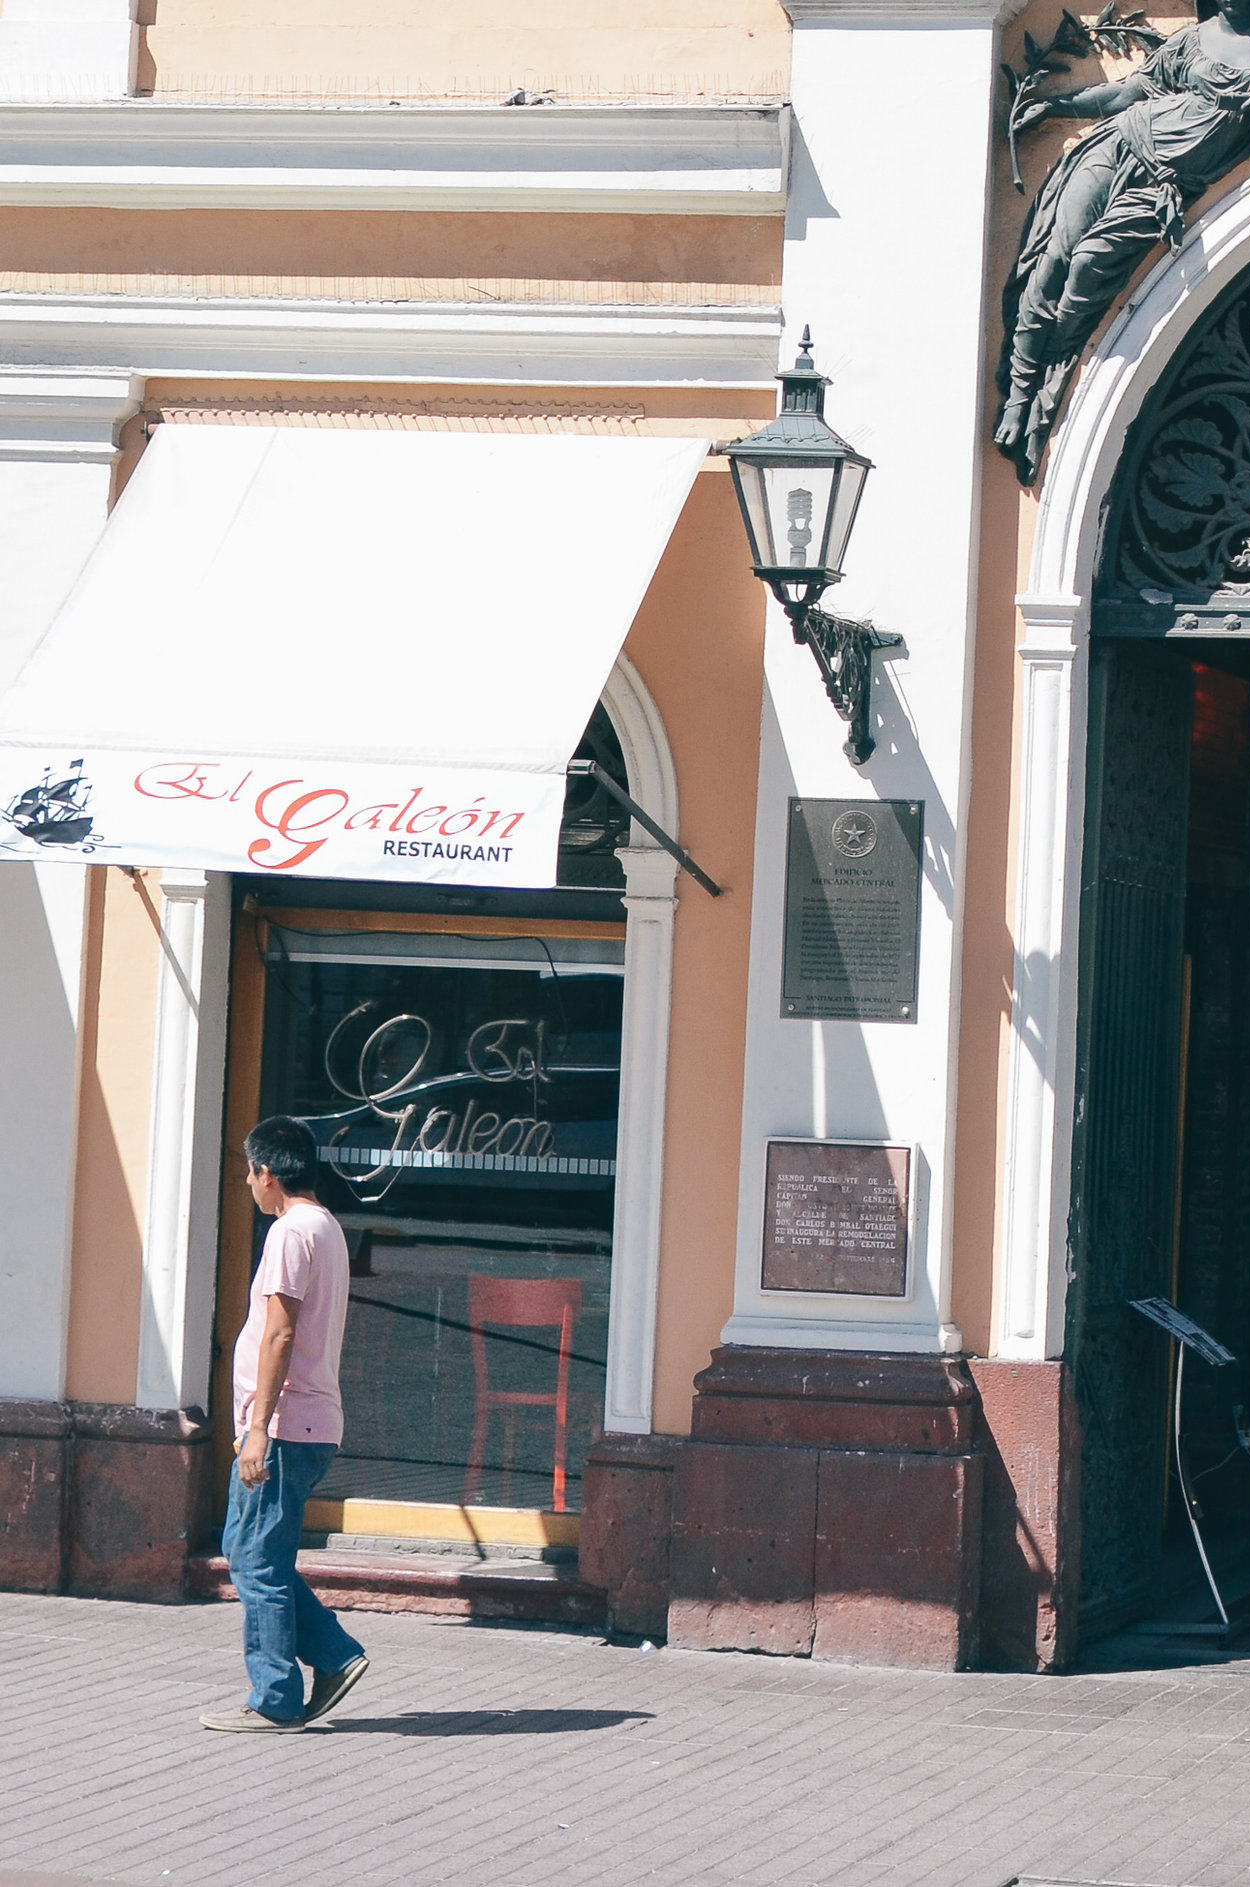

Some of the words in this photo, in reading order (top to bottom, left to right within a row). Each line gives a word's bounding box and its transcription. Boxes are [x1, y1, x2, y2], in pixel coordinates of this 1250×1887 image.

[134, 762, 253, 803] El
[247, 779, 526, 869] Galeón
[383, 840, 514, 864] RESTAURANT
[778, 1174, 805, 1182] SIENDO
[863, 1196, 895, 1204] GENERAL
[787, 1228, 823, 1236] INAUGURA
[838, 1231, 896, 1240] REMODELACION
[792, 1237, 812, 1245] ESTE
[861, 1241, 896, 1249] CENTRAL
